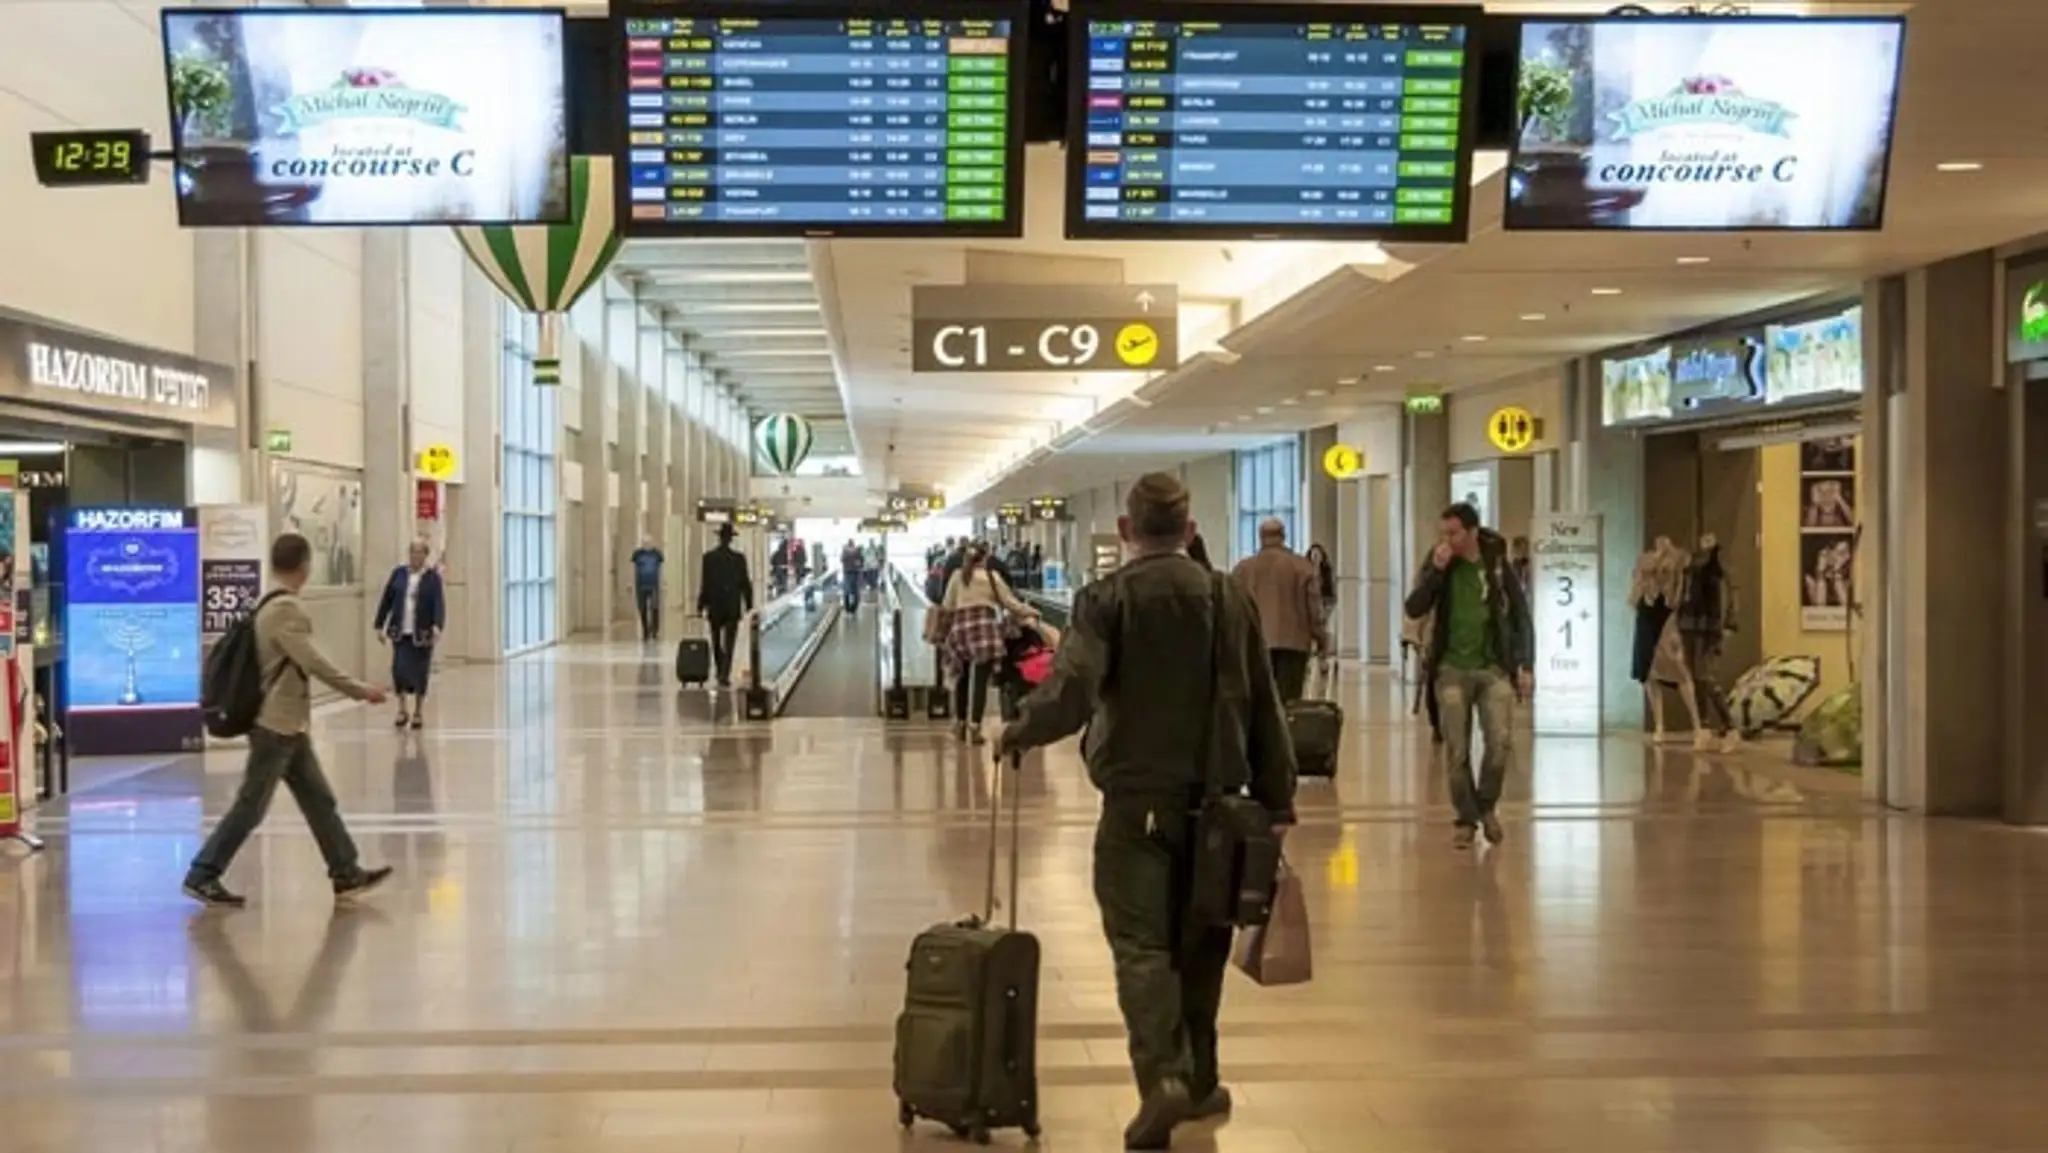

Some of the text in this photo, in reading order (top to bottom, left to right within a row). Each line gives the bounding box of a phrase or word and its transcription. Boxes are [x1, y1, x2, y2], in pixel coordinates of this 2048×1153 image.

[55, 140, 131, 170] 12:39
[271, 149, 476, 178] concourse C
[331, 144, 413, 157] located at
[1658, 150, 1739, 162] located at
[1599, 155, 1798, 184] concourse C
[933, 325, 988, 366] C1
[1038, 324, 1100, 366] C9
[27, 341, 148, 400] HAZORFIM
[77, 510, 184, 530] HAZORFIM
[1550, 520, 1579, 537] New
[206, 585, 258, 611] 35%
[1556, 577, 1574, 606] 3
[1558, 619, 1574, 649] 1
